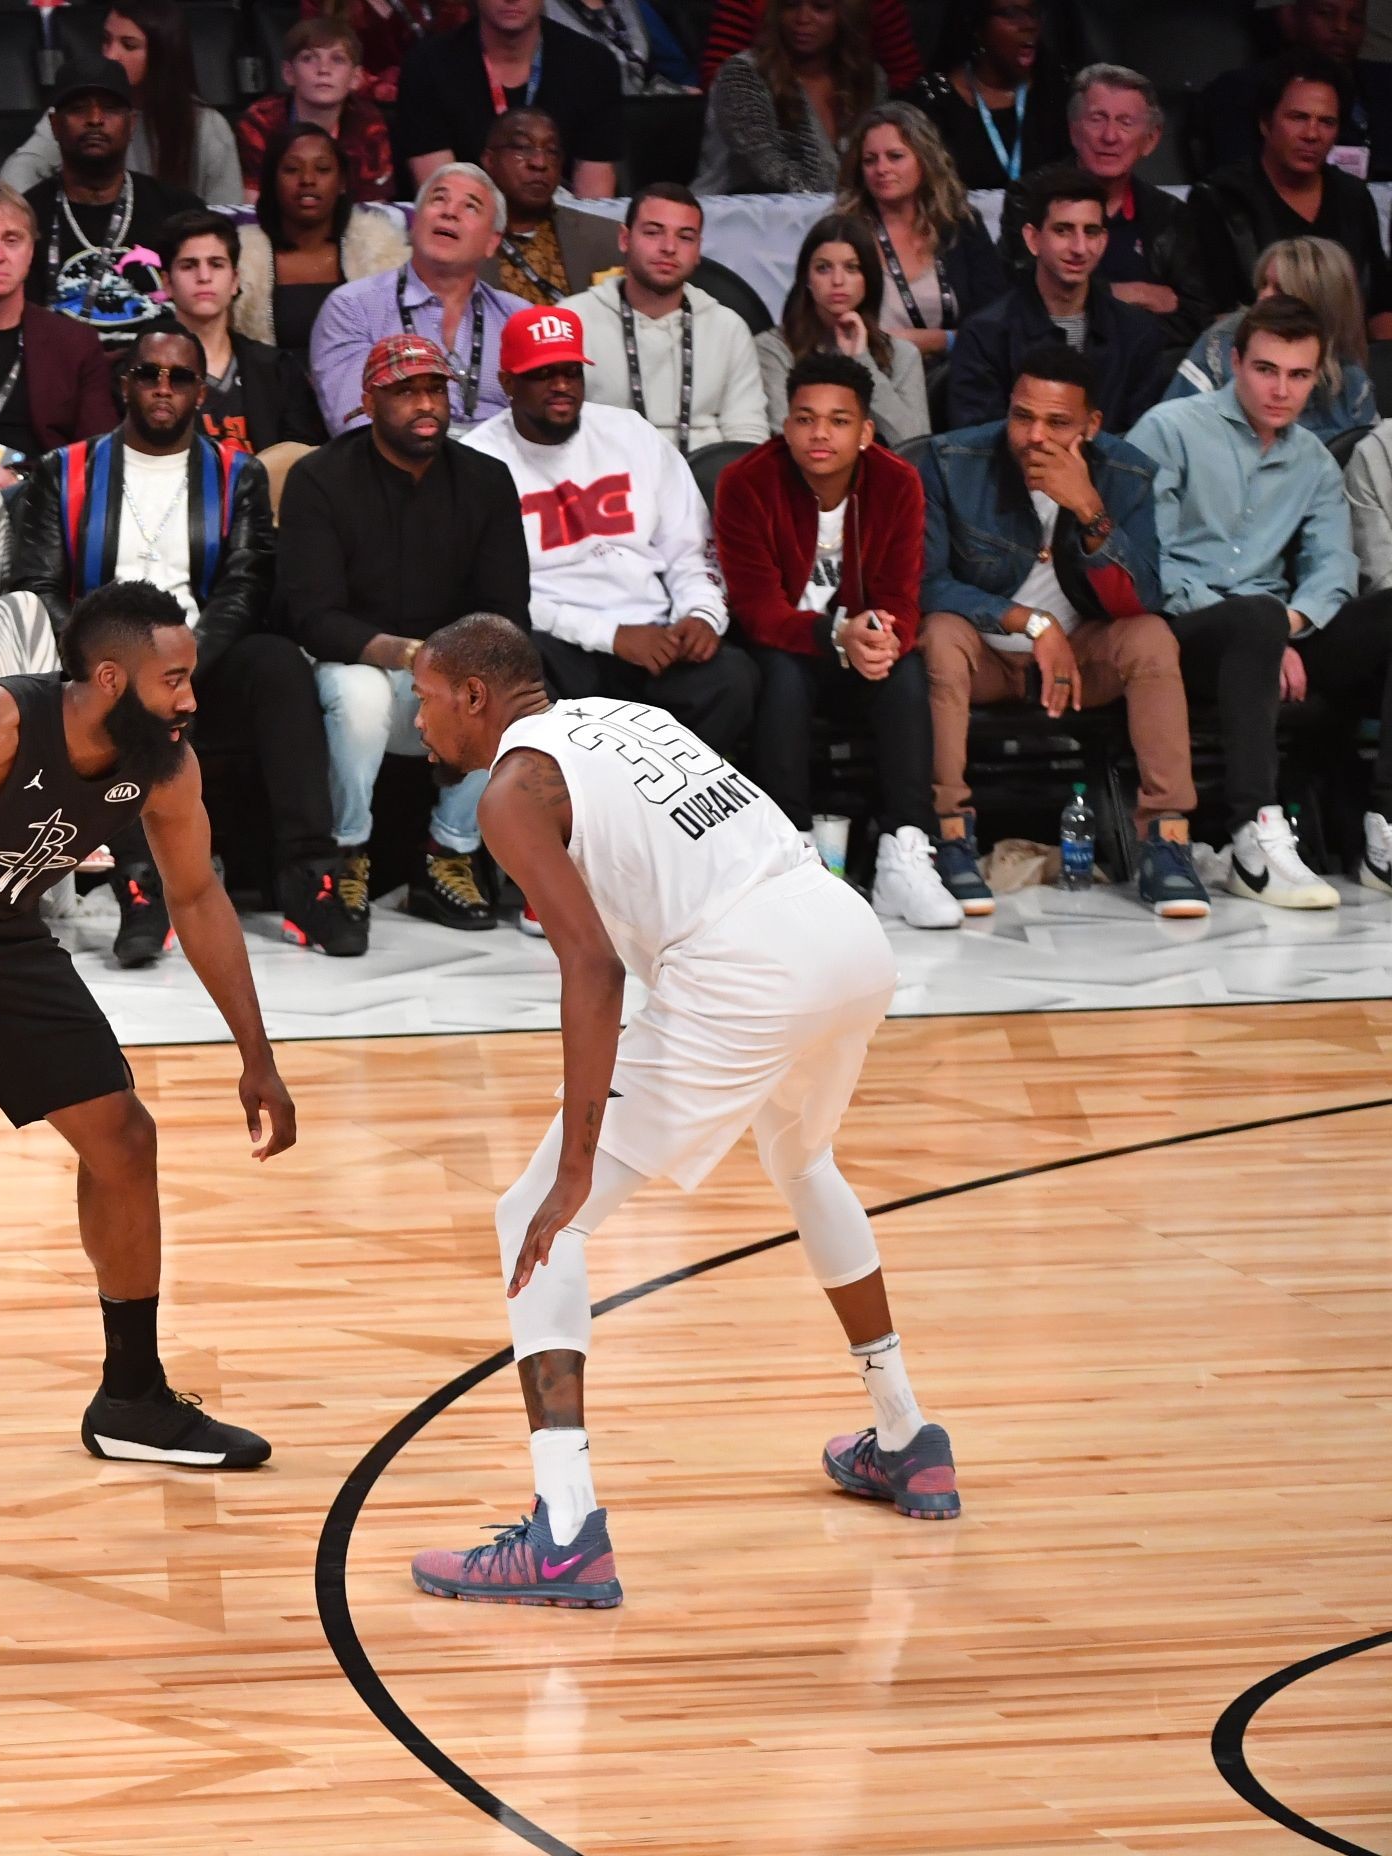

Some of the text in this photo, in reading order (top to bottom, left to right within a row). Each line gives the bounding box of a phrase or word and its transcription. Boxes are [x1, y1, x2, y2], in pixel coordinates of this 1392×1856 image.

[526, 315, 575, 342] TDE
[567, 702, 725, 806] 35
[668, 772, 761, 841] DURANT
